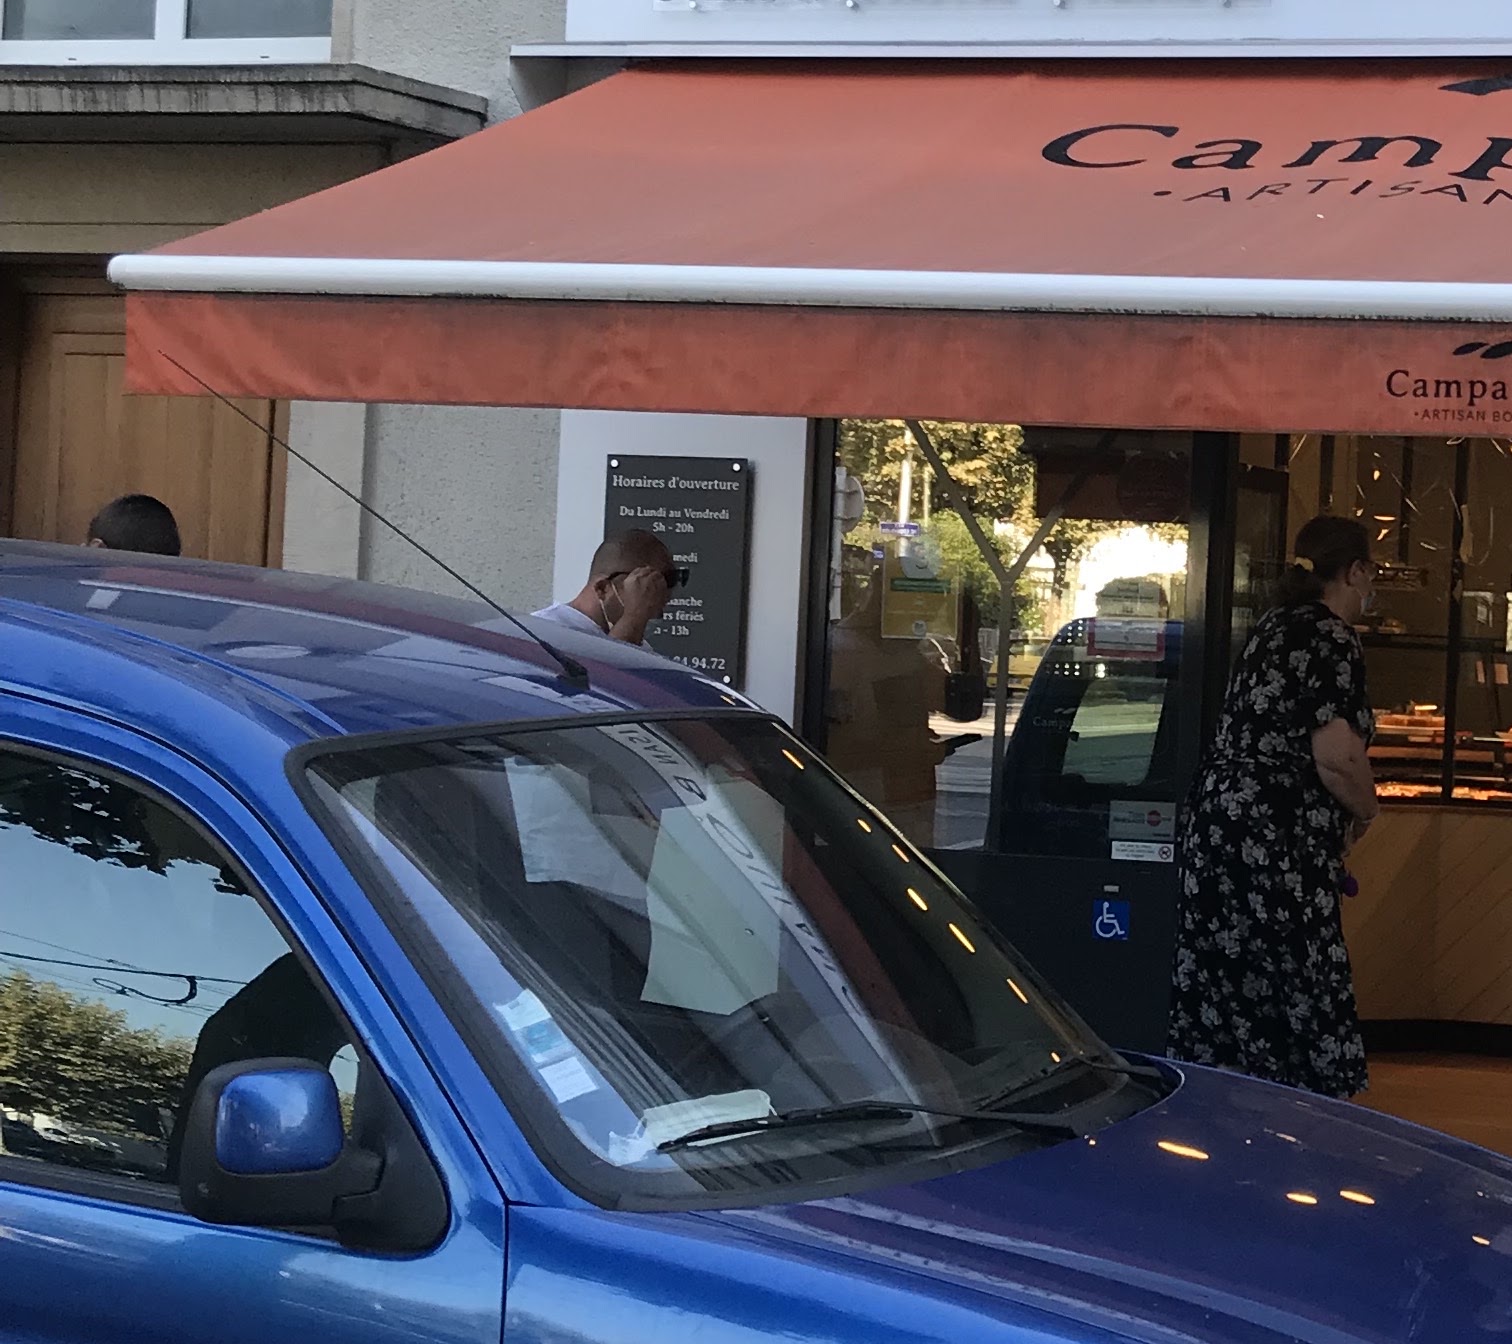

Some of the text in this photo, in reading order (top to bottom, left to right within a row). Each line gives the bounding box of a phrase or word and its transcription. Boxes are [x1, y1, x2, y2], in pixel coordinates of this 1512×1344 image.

[1420, 409, 1486, 421] ARTISAN
[612, 475, 740, 491] Horaires d'ouverture
[619, 506, 729, 520] Du Lundi au Vendredi
[652, 522, 665, 532] 5h
[675, 522, 694, 533] 20h
[672, 552, 698, 563] medi
[675, 610, 704, 621] fériés
[671, 625, 690, 636] 13h
